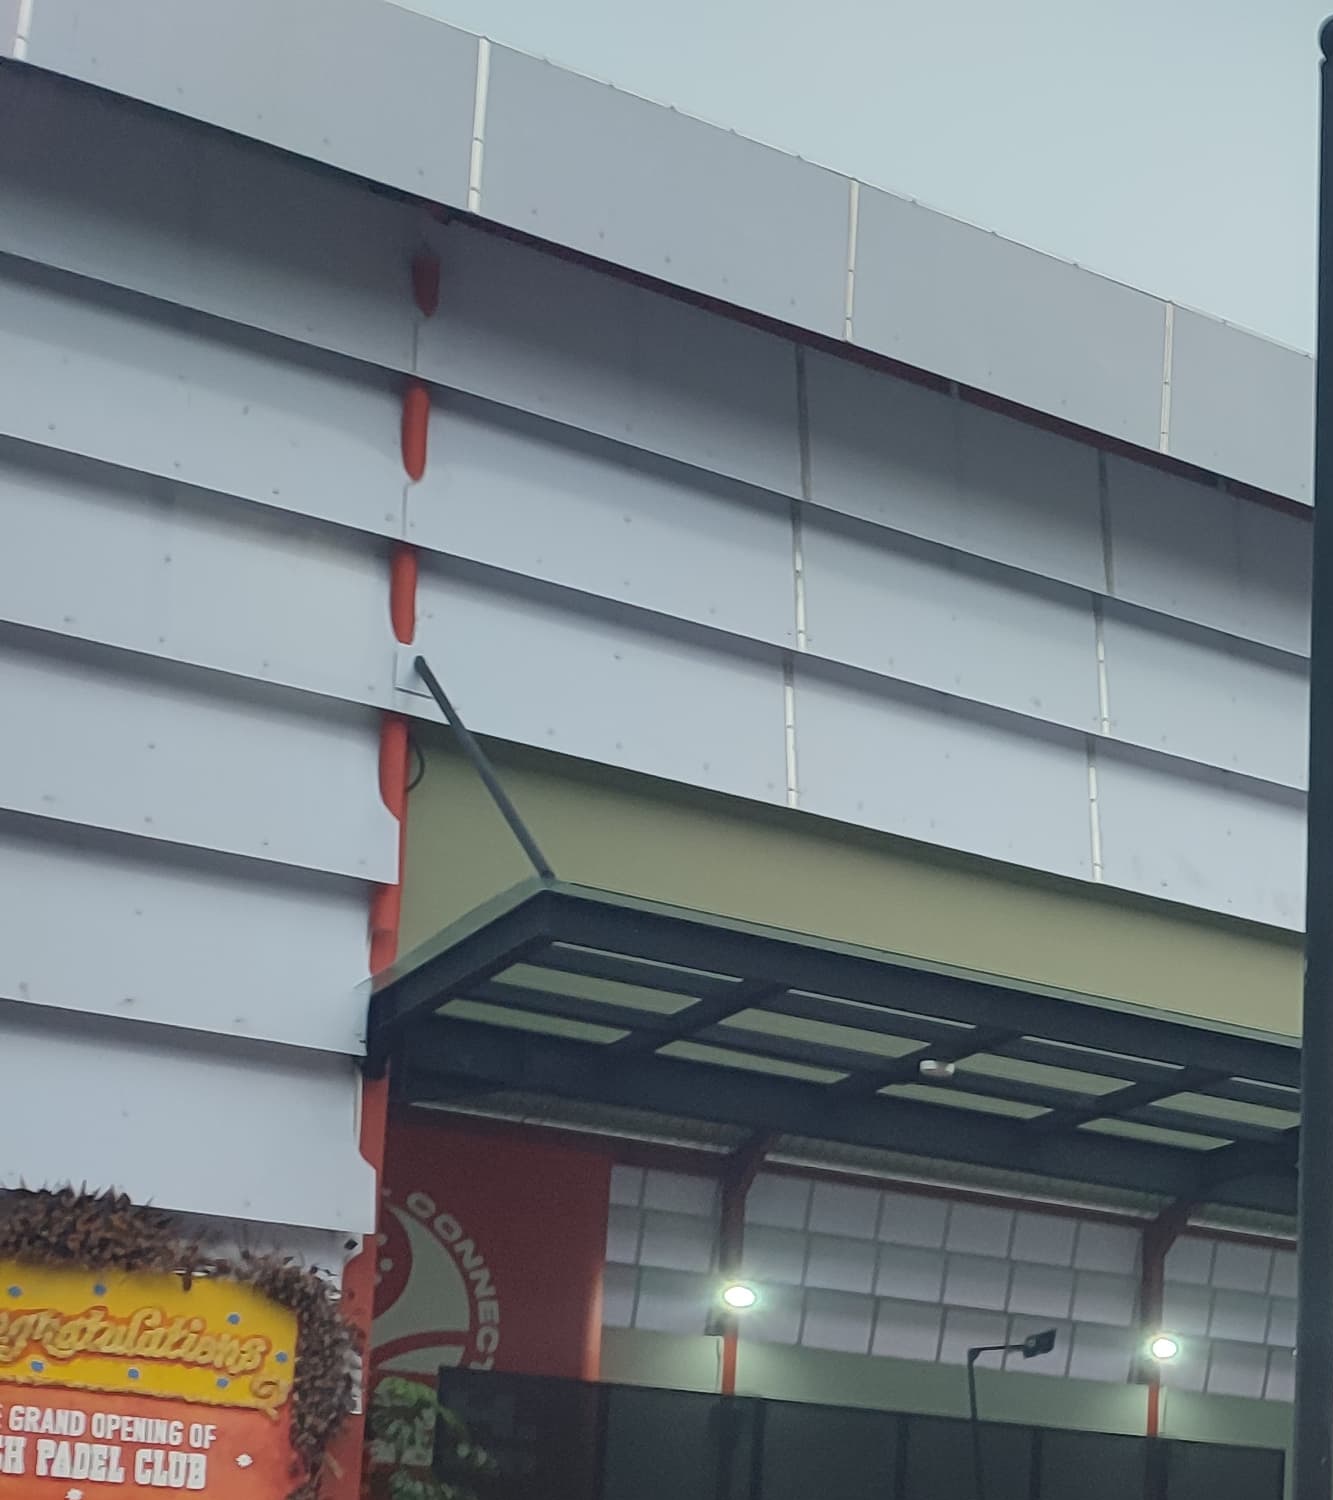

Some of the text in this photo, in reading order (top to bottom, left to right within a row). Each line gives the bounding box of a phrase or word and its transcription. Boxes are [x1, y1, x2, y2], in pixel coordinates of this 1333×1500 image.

[8, 1405, 87, 1437] GRAND
[91, 1412, 184, 1445] OPENING
[189, 1422, 217, 1449] OF
[36, 1438, 125, 1484] PADEL
[134, 1448, 207, 1490] CLUB
